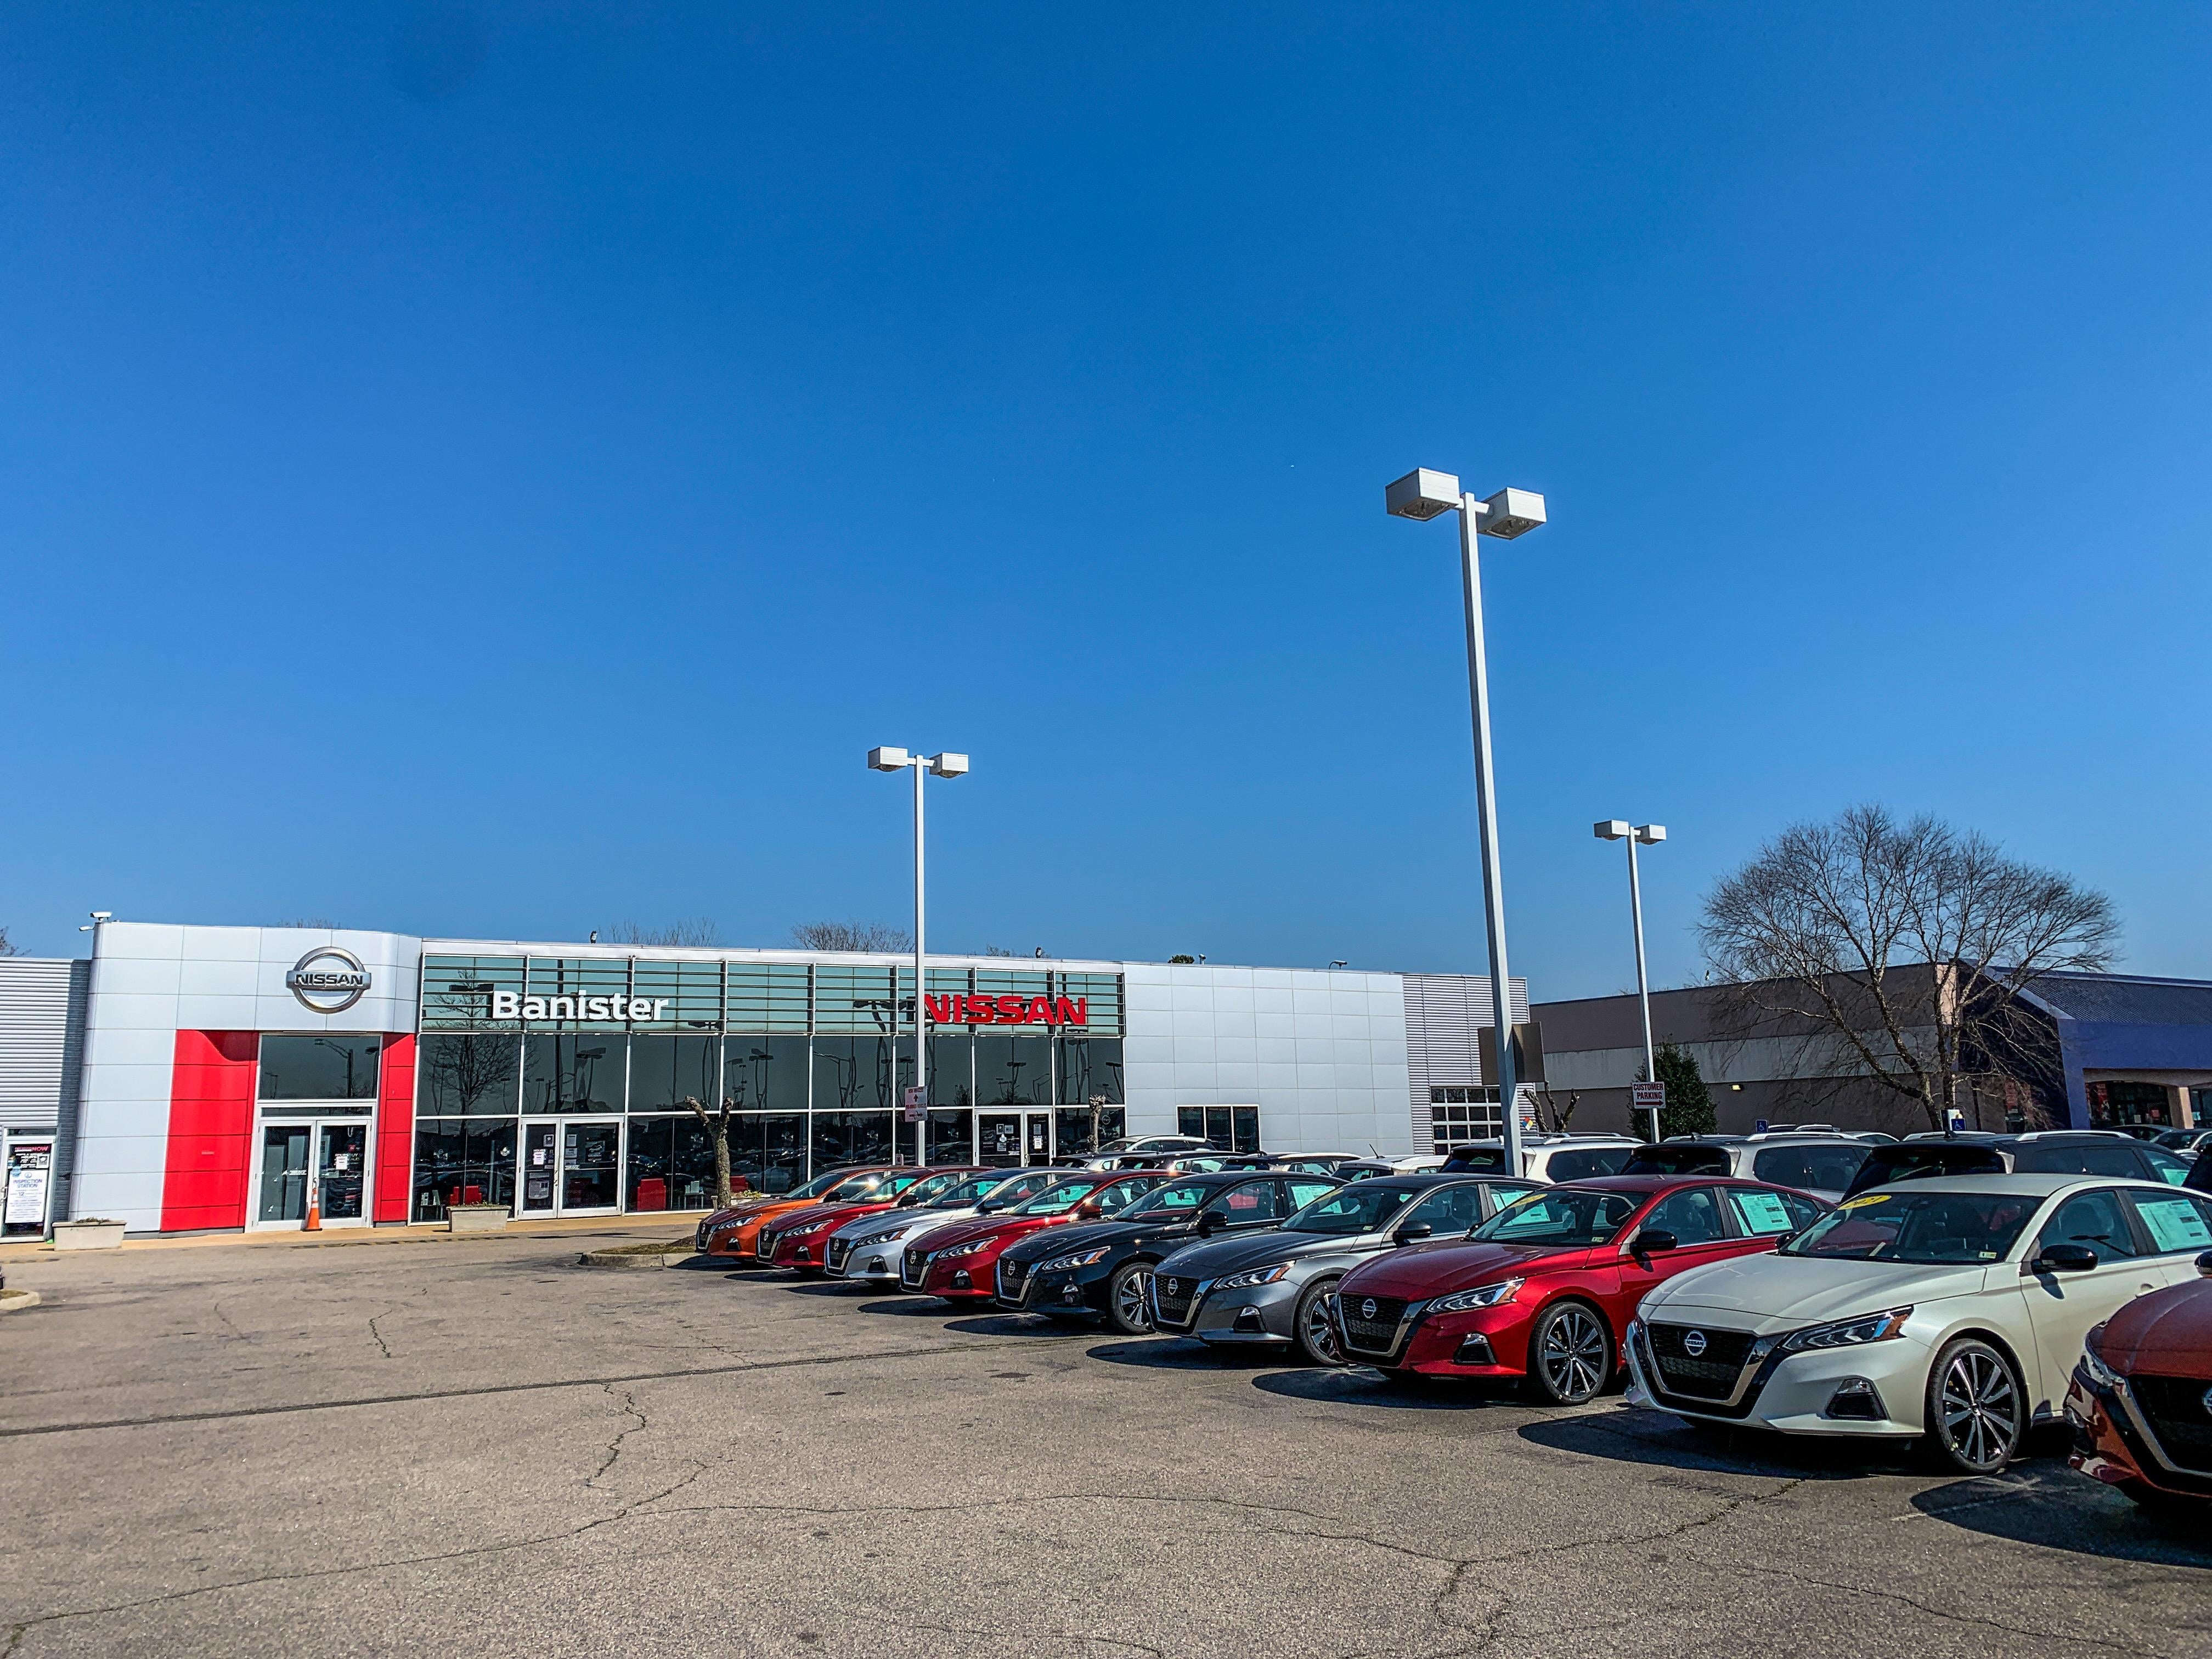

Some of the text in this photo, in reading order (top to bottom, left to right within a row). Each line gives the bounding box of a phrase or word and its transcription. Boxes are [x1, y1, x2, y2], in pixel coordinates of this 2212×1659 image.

[295, 973, 363, 986] NISSAN
[492, 989, 669, 1020] Banister
[924, 994, 1086, 1024] NISSAN
[1637, 1091, 1662, 1099] PARKING
